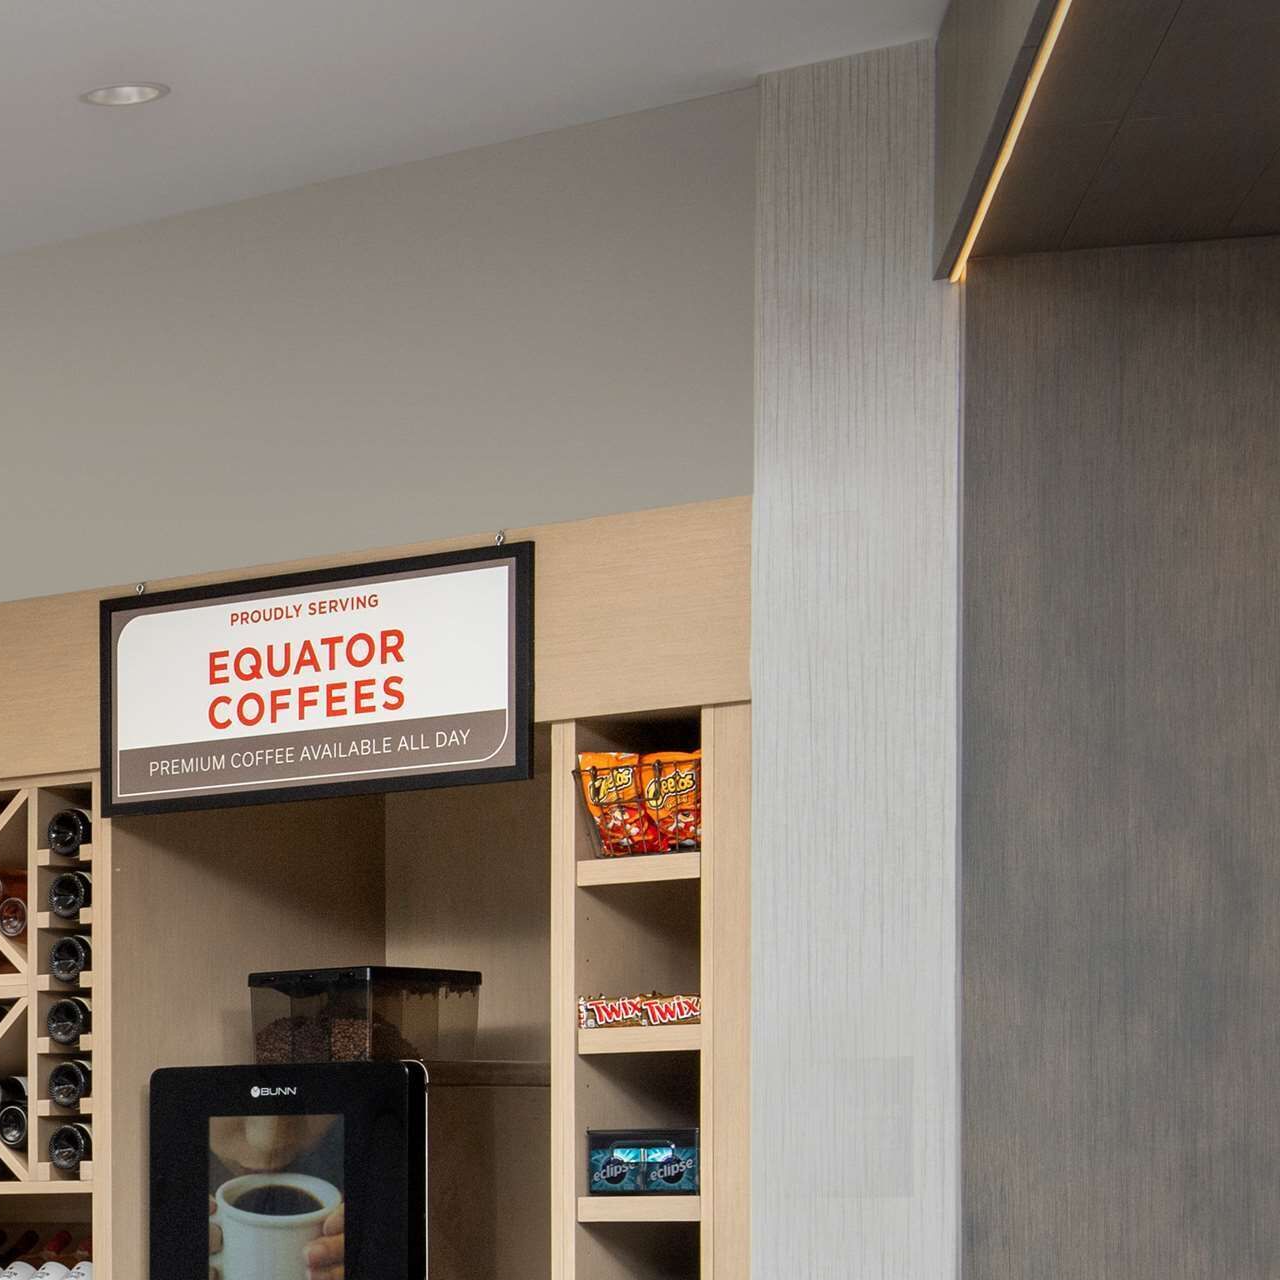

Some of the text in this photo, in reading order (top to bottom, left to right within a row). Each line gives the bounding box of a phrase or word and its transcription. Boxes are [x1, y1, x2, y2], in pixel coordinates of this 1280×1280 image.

[230, 594, 379, 627] PROUDLY SERVING
[209, 629, 405, 685] EQUATOR
[208, 676, 405, 730] COFFEES
[149, 728, 471, 777] PREMIUM COFFEE AVAILABLE ALL DAY
[260, 1087, 297, 1096] BUNN
[650, 1158, 693, 1181] eclipse
